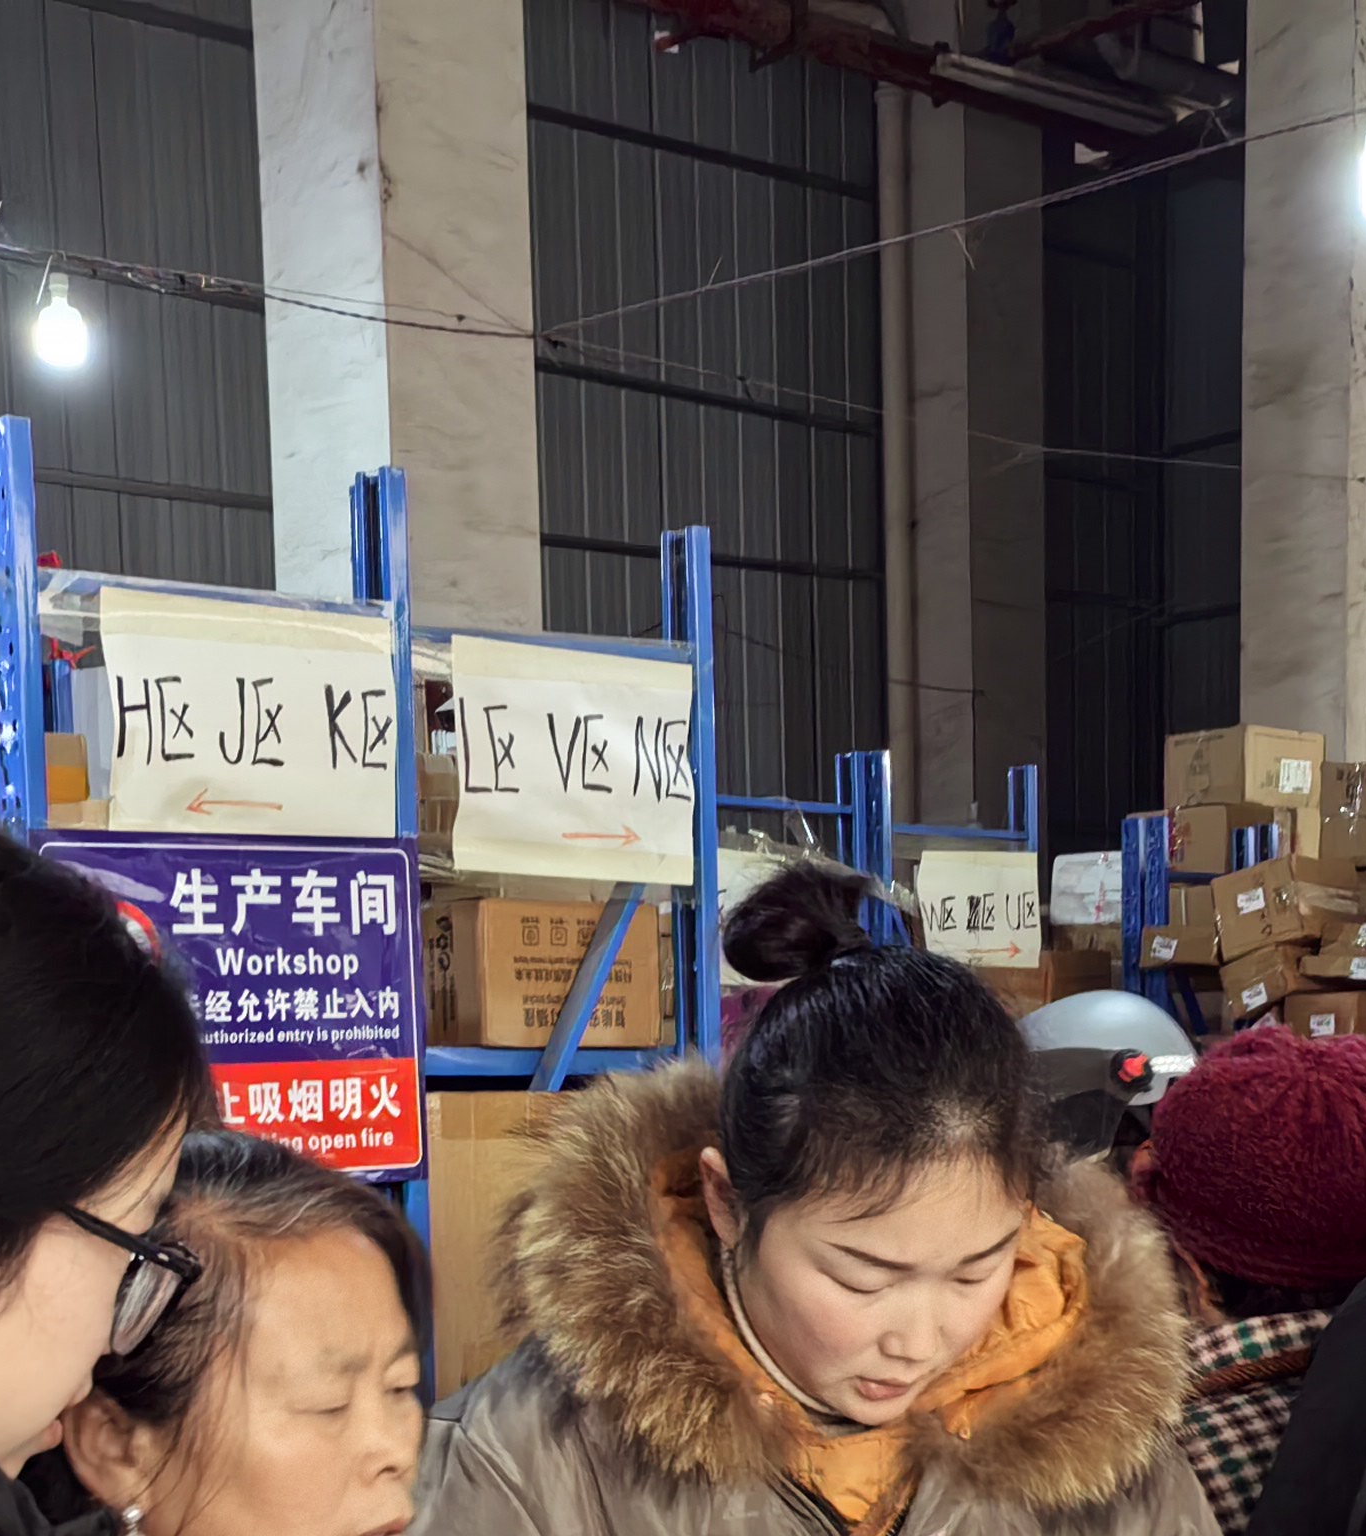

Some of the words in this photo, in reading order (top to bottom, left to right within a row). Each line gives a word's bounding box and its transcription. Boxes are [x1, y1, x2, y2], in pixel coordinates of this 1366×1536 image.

[116, 676, 194, 765] H区
[219, 677, 284, 768] J区
[324, 684, 393, 771] K区
[458, 697, 520, 794] L区
[547, 712, 612, 794] V区
[634, 715, 692, 802] N区
[170, 868, 397, 936] 生产车间
[216, 947, 359, 980] Workshop
[200, 1027, 275, 1044] uthorized
[277, 1028, 314, 1045] entry
[317, 1026, 328, 1042] is
[331, 1024, 400, 1043] prohibited
[219, 1076, 401, 1125] 止吸烟明火
[308, 1131, 357, 1154] open
[360, 1127, 394, 1148] fire
